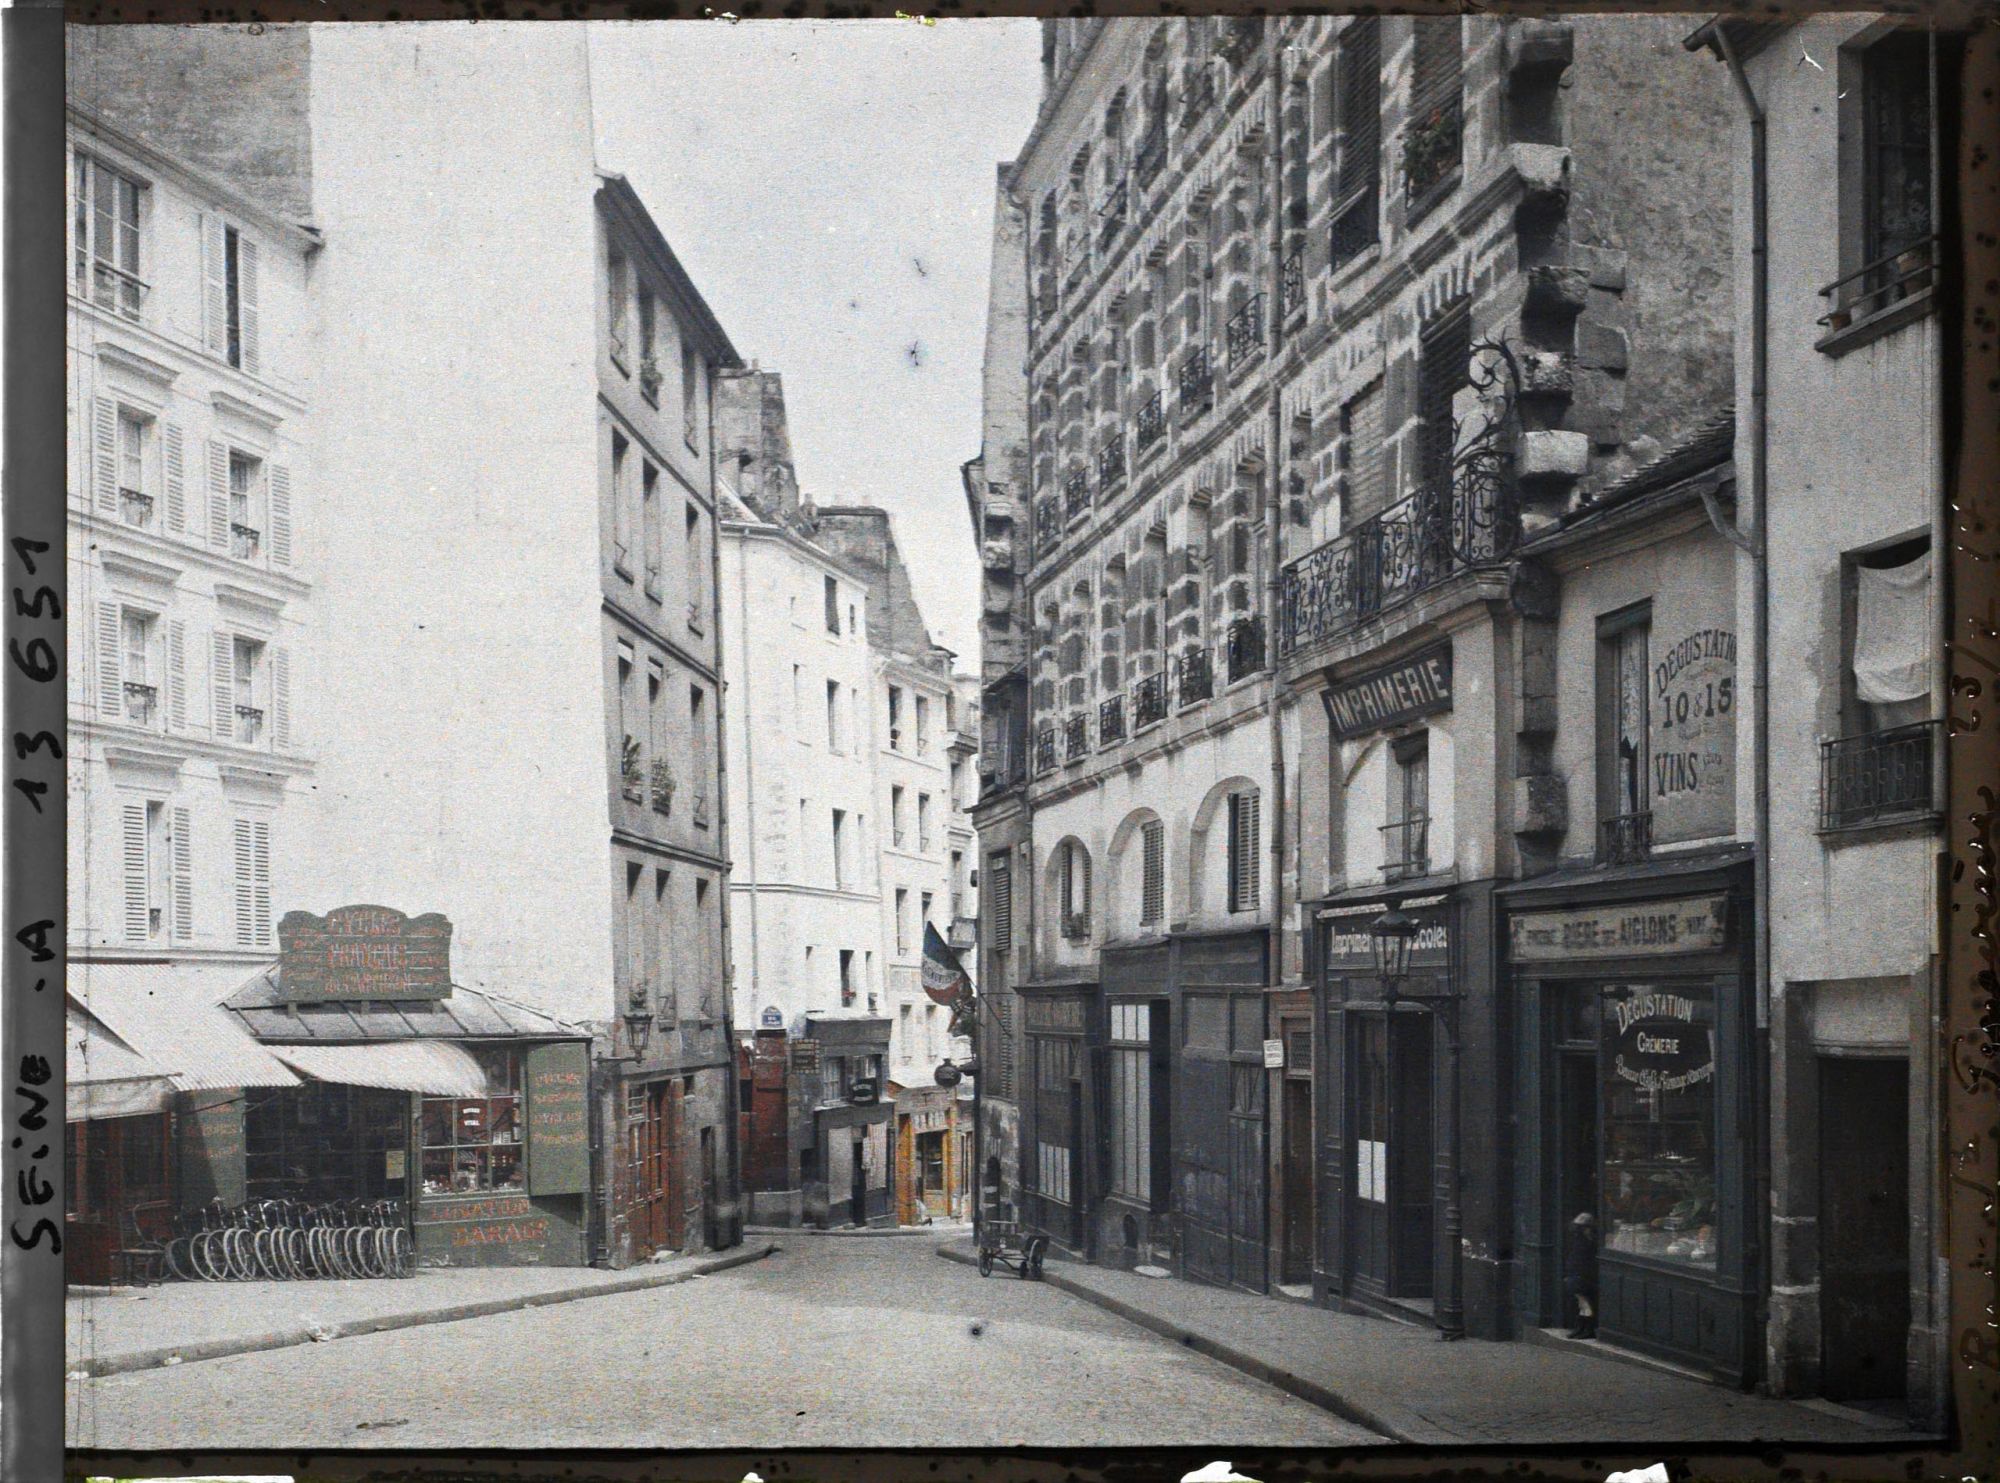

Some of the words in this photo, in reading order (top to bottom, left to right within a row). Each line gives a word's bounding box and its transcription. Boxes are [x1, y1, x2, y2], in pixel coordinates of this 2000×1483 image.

[11, 538, 61, 682] 651
[1328, 658, 1449, 733] IMPRIMERIE
[1663, 691, 1689, 728] 10
[1705, 677, 1732, 717] 15
[14, 731, 63, 813] 13
[1655, 752, 1698, 796] VINS
[1620, 914, 1676, 946] AIGLONS
[451, 1219, 549, 1247] GARAGE
